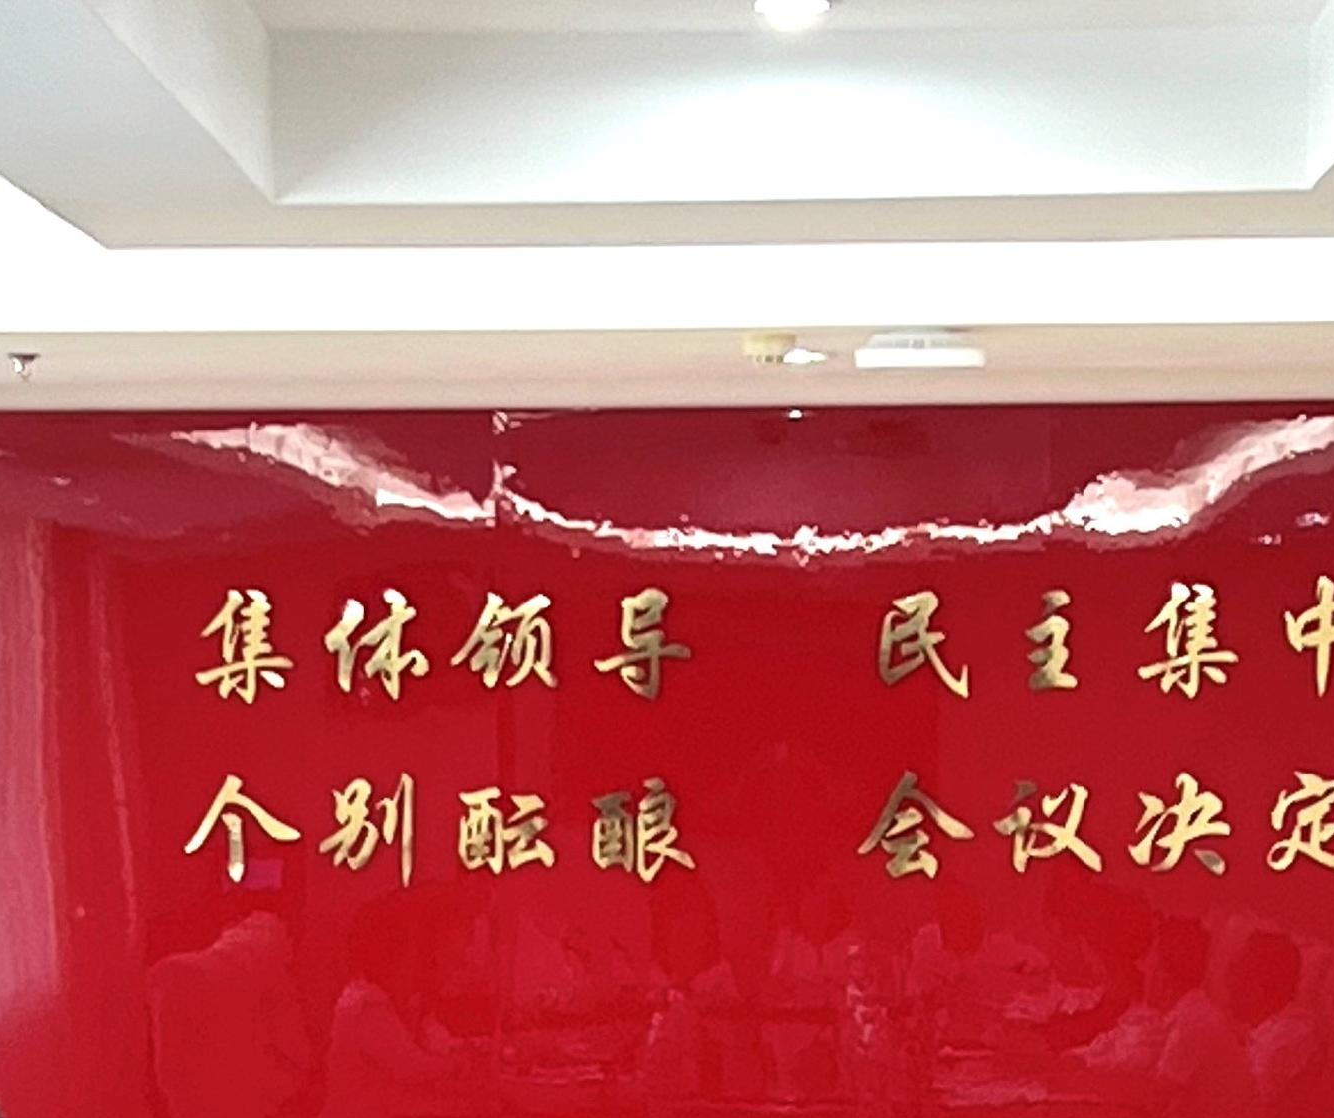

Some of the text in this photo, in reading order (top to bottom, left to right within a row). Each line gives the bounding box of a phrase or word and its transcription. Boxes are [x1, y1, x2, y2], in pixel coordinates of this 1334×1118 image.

[194, 588, 692, 704] 集体领导
[183, 773, 696, 887] 个别酝酿
